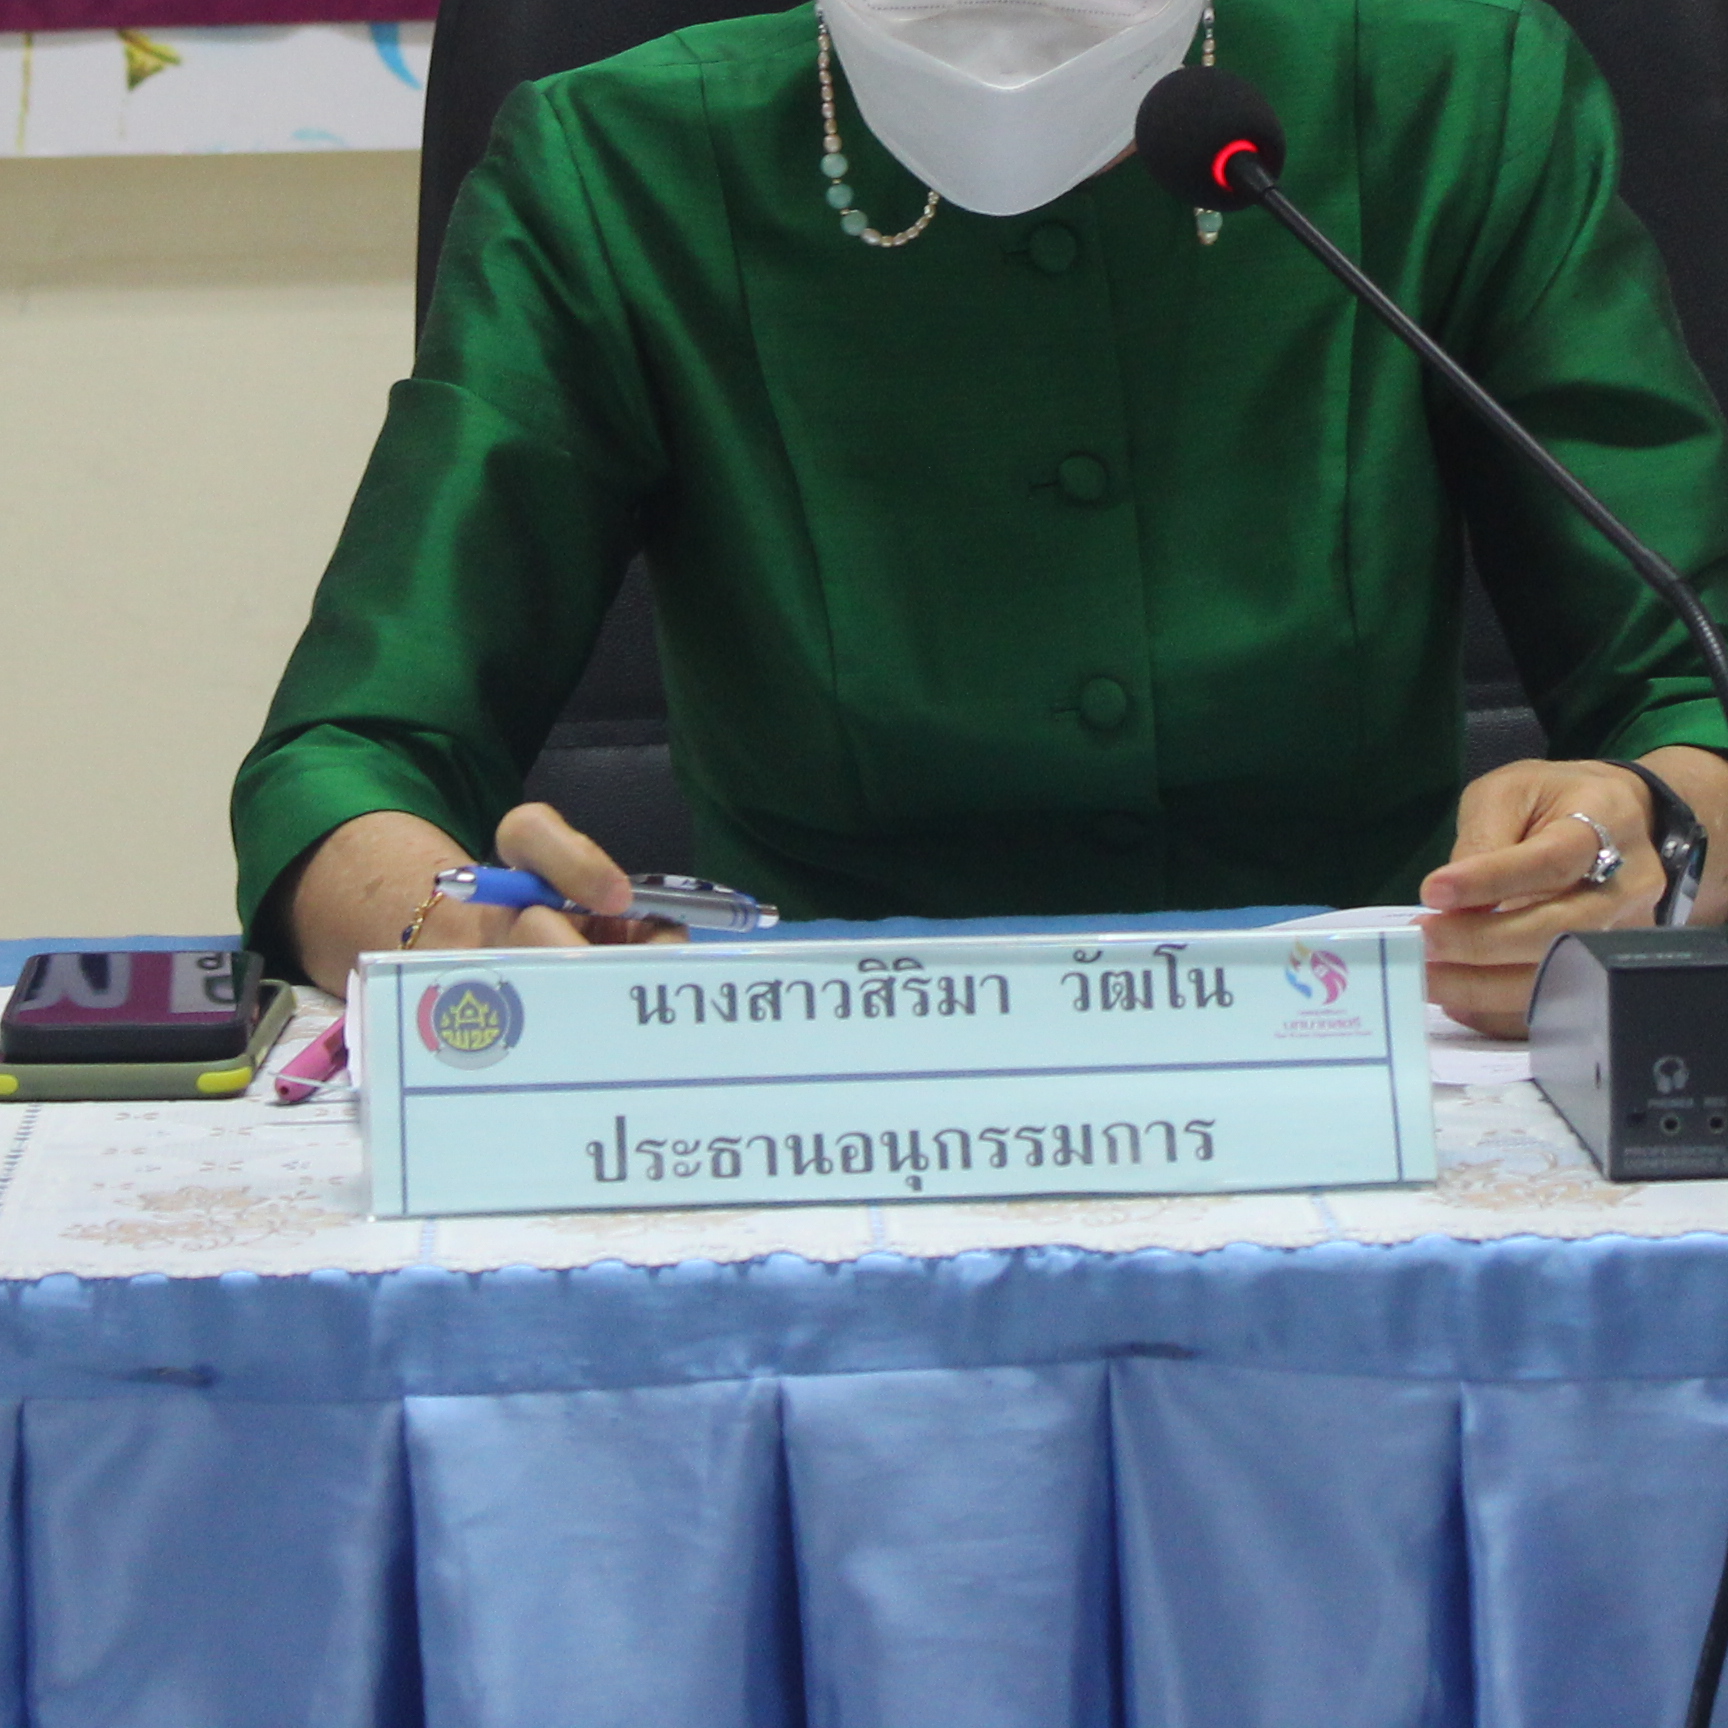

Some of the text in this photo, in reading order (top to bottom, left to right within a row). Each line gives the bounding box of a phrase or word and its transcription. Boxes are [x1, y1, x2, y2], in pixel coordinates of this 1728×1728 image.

[630, 943, 1235, 1026] นางสาวสิริมา วัฒโน
[585, 1115, 1218, 1192] ประธานอนุกรรมการ
